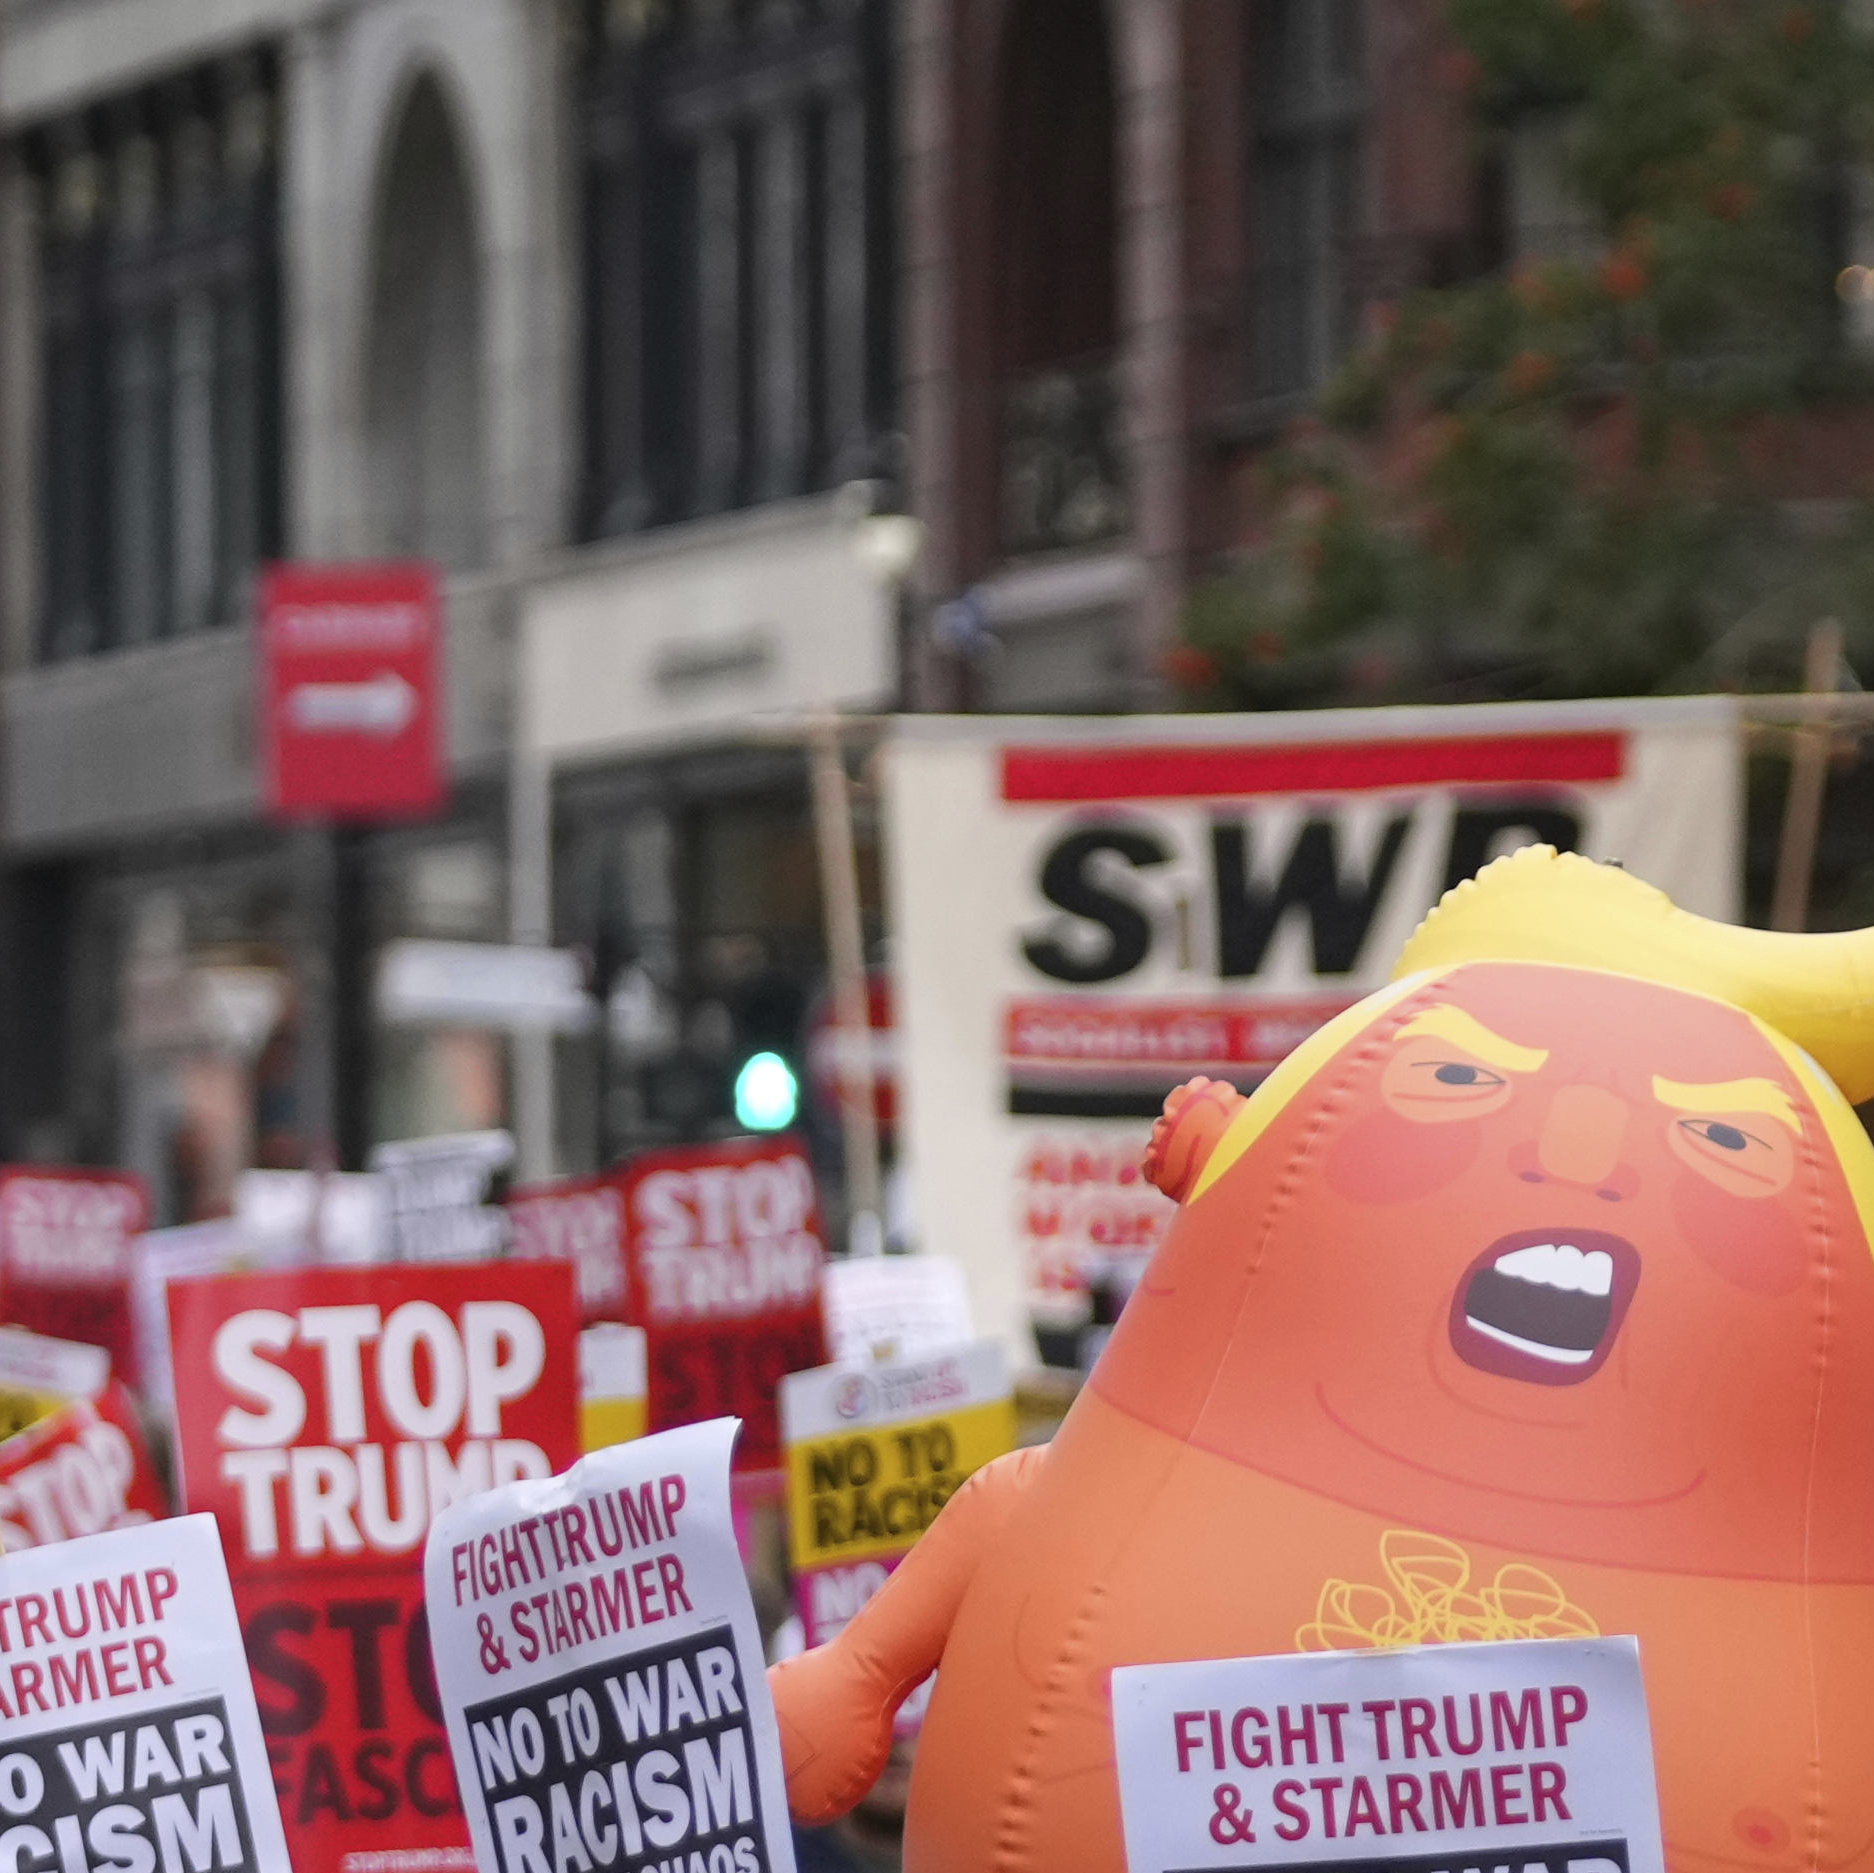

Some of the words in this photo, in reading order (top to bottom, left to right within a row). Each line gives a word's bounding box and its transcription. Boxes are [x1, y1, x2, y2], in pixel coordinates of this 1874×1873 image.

[213, 1300, 545, 1448] STOP
[809, 1440, 879, 1489] NO
[896, 1422, 956, 1472] TO
[58, 1715, 231, 1800] WAR
[473, 1708, 544, 1789] NO
[548, 1688, 600, 1763] TO
[605, 1647, 743, 1743] WAR
[1175, 1704, 1349, 1772] FIGHT
[1364, 1687, 1587, 1760] TRUMP
[1210, 1785, 1255, 1845] &
[1274, 1763, 1570, 1841] STARMER
